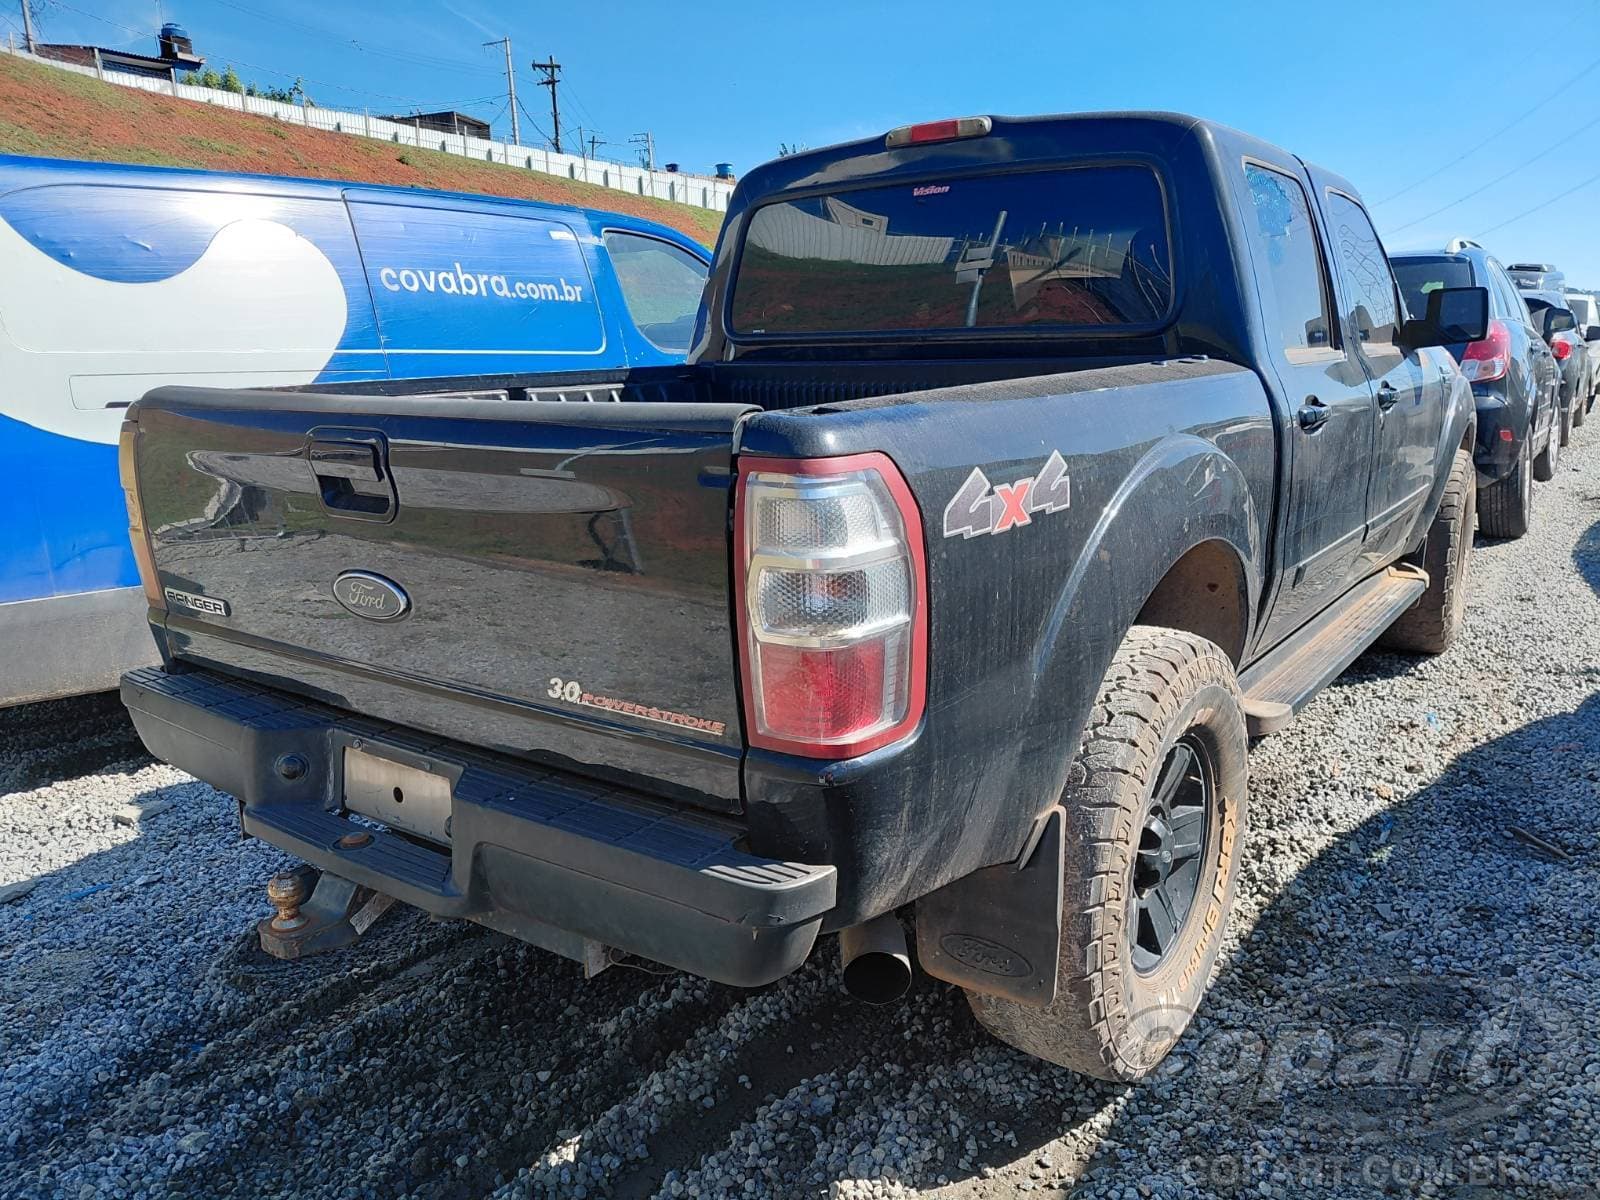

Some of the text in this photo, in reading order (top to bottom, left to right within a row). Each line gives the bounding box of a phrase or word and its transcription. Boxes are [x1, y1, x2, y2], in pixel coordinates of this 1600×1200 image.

[380, 263, 582, 302] covabra.com.br
[943, 449, 1070, 540] 4x4
[166, 591, 227, 616] RANGER
[350, 581, 386, 610] Ford
[581, 693, 726, 734] POWERSTROKE
[951, 937, 1014, 973] Ford
